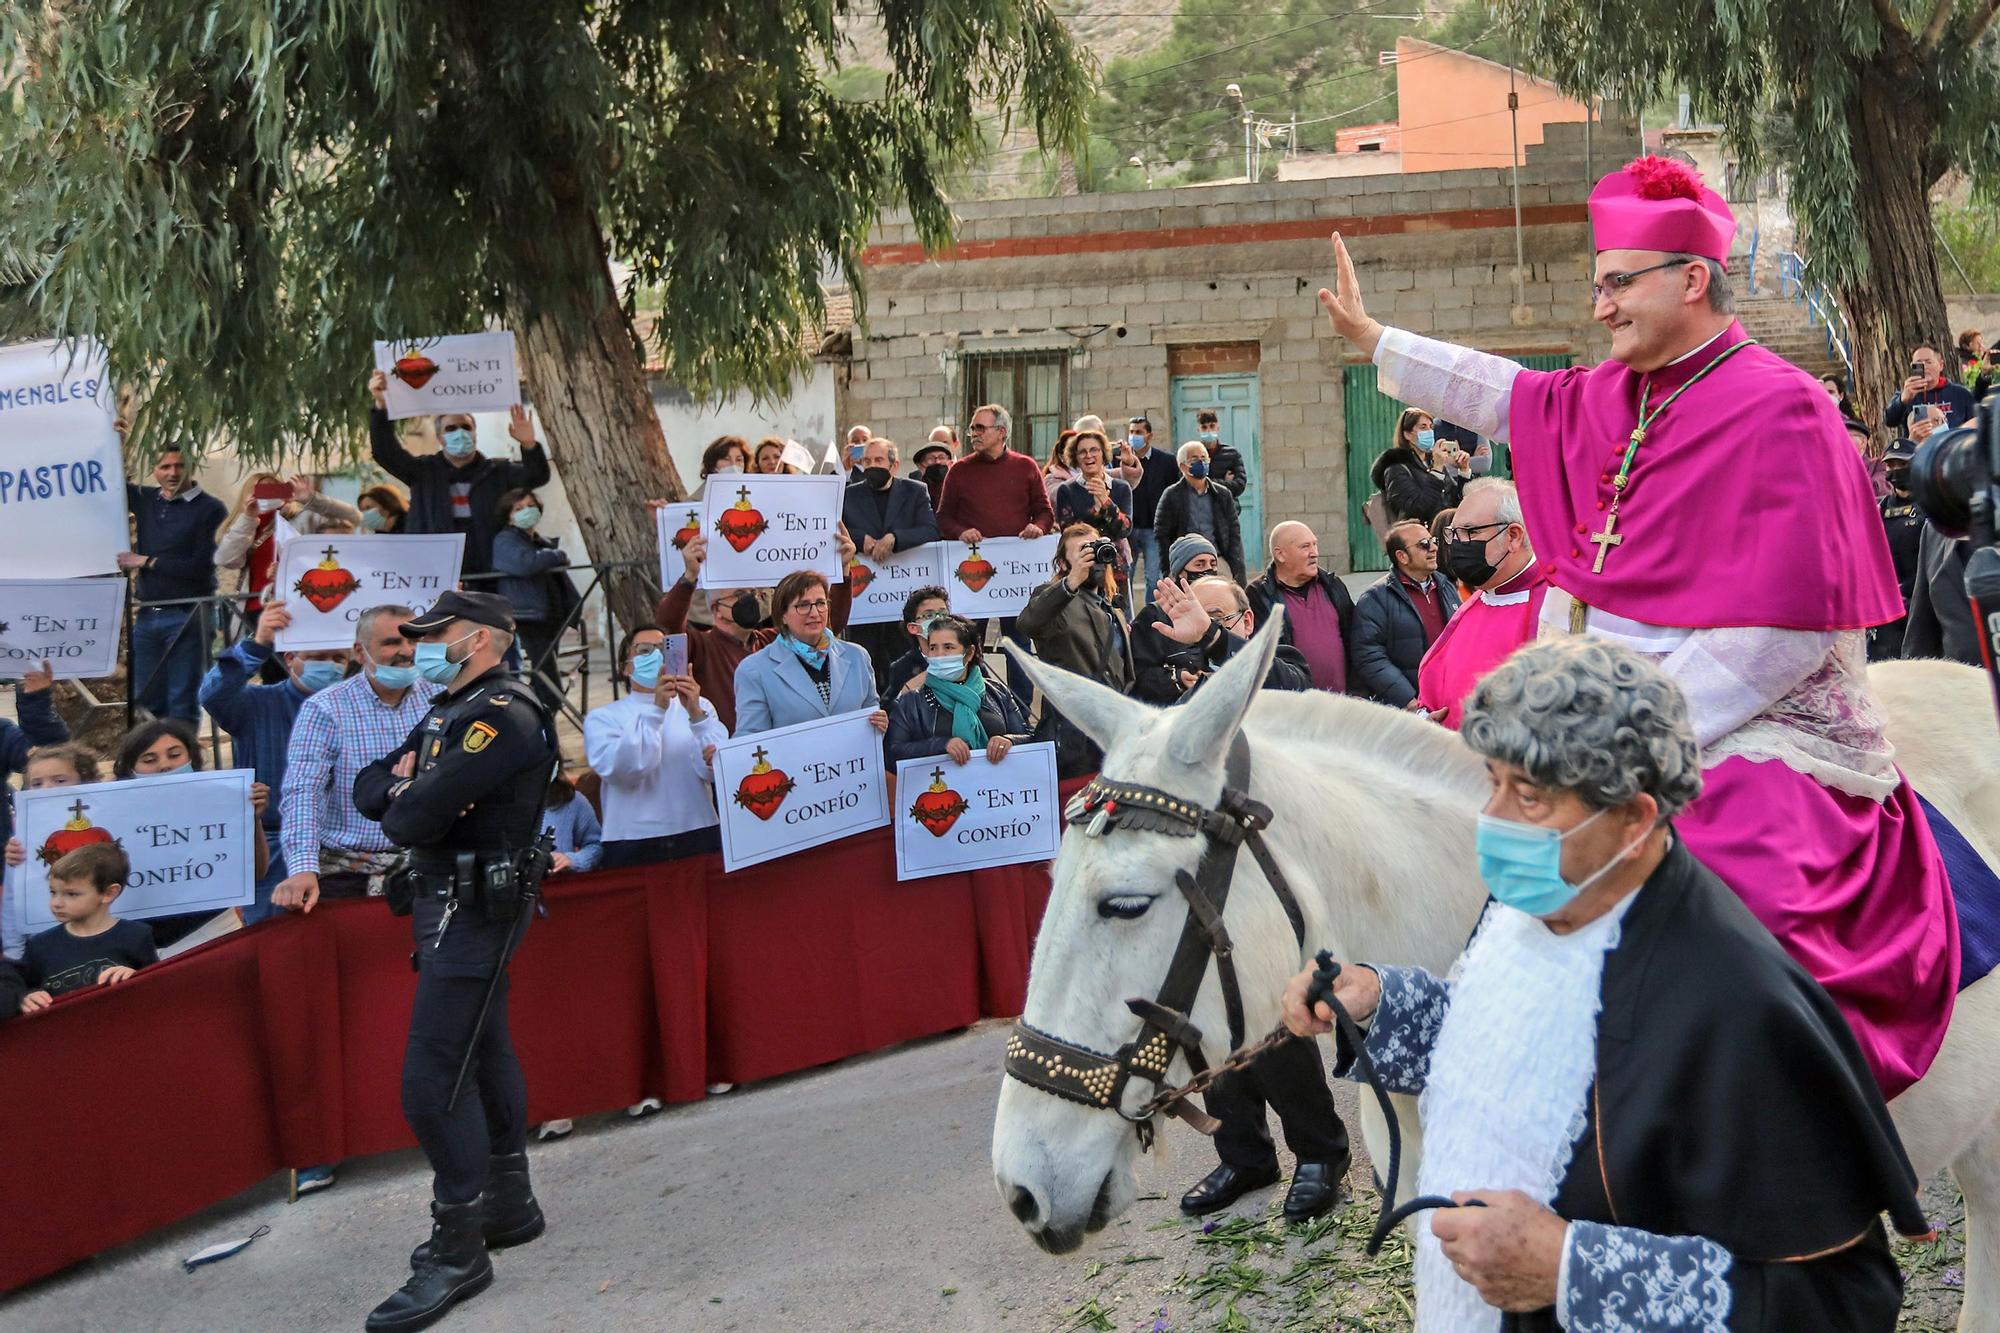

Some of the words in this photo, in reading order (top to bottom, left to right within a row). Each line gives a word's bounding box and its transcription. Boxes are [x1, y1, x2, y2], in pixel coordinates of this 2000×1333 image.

[484, 359, 500, 371] TI
[0, 460, 107, 504] PASTOR
[812, 517, 828, 530] TI
[755, 541, 827, 562] CONFÍO”
[915, 566, 930, 577] TI
[1035, 562, 1050, 574] TI
[419, 576, 440, 589] TI
[76, 618, 98, 631] TI
[846, 757, 866, 774] TI
[785, 783, 867, 824] CONFÍO”
[1020, 789, 1039, 804] TI
[200, 823, 227, 840] TI
[957, 814, 1040, 845] CONFÍO”
[126, 853, 228, 888] ONFÍO”
